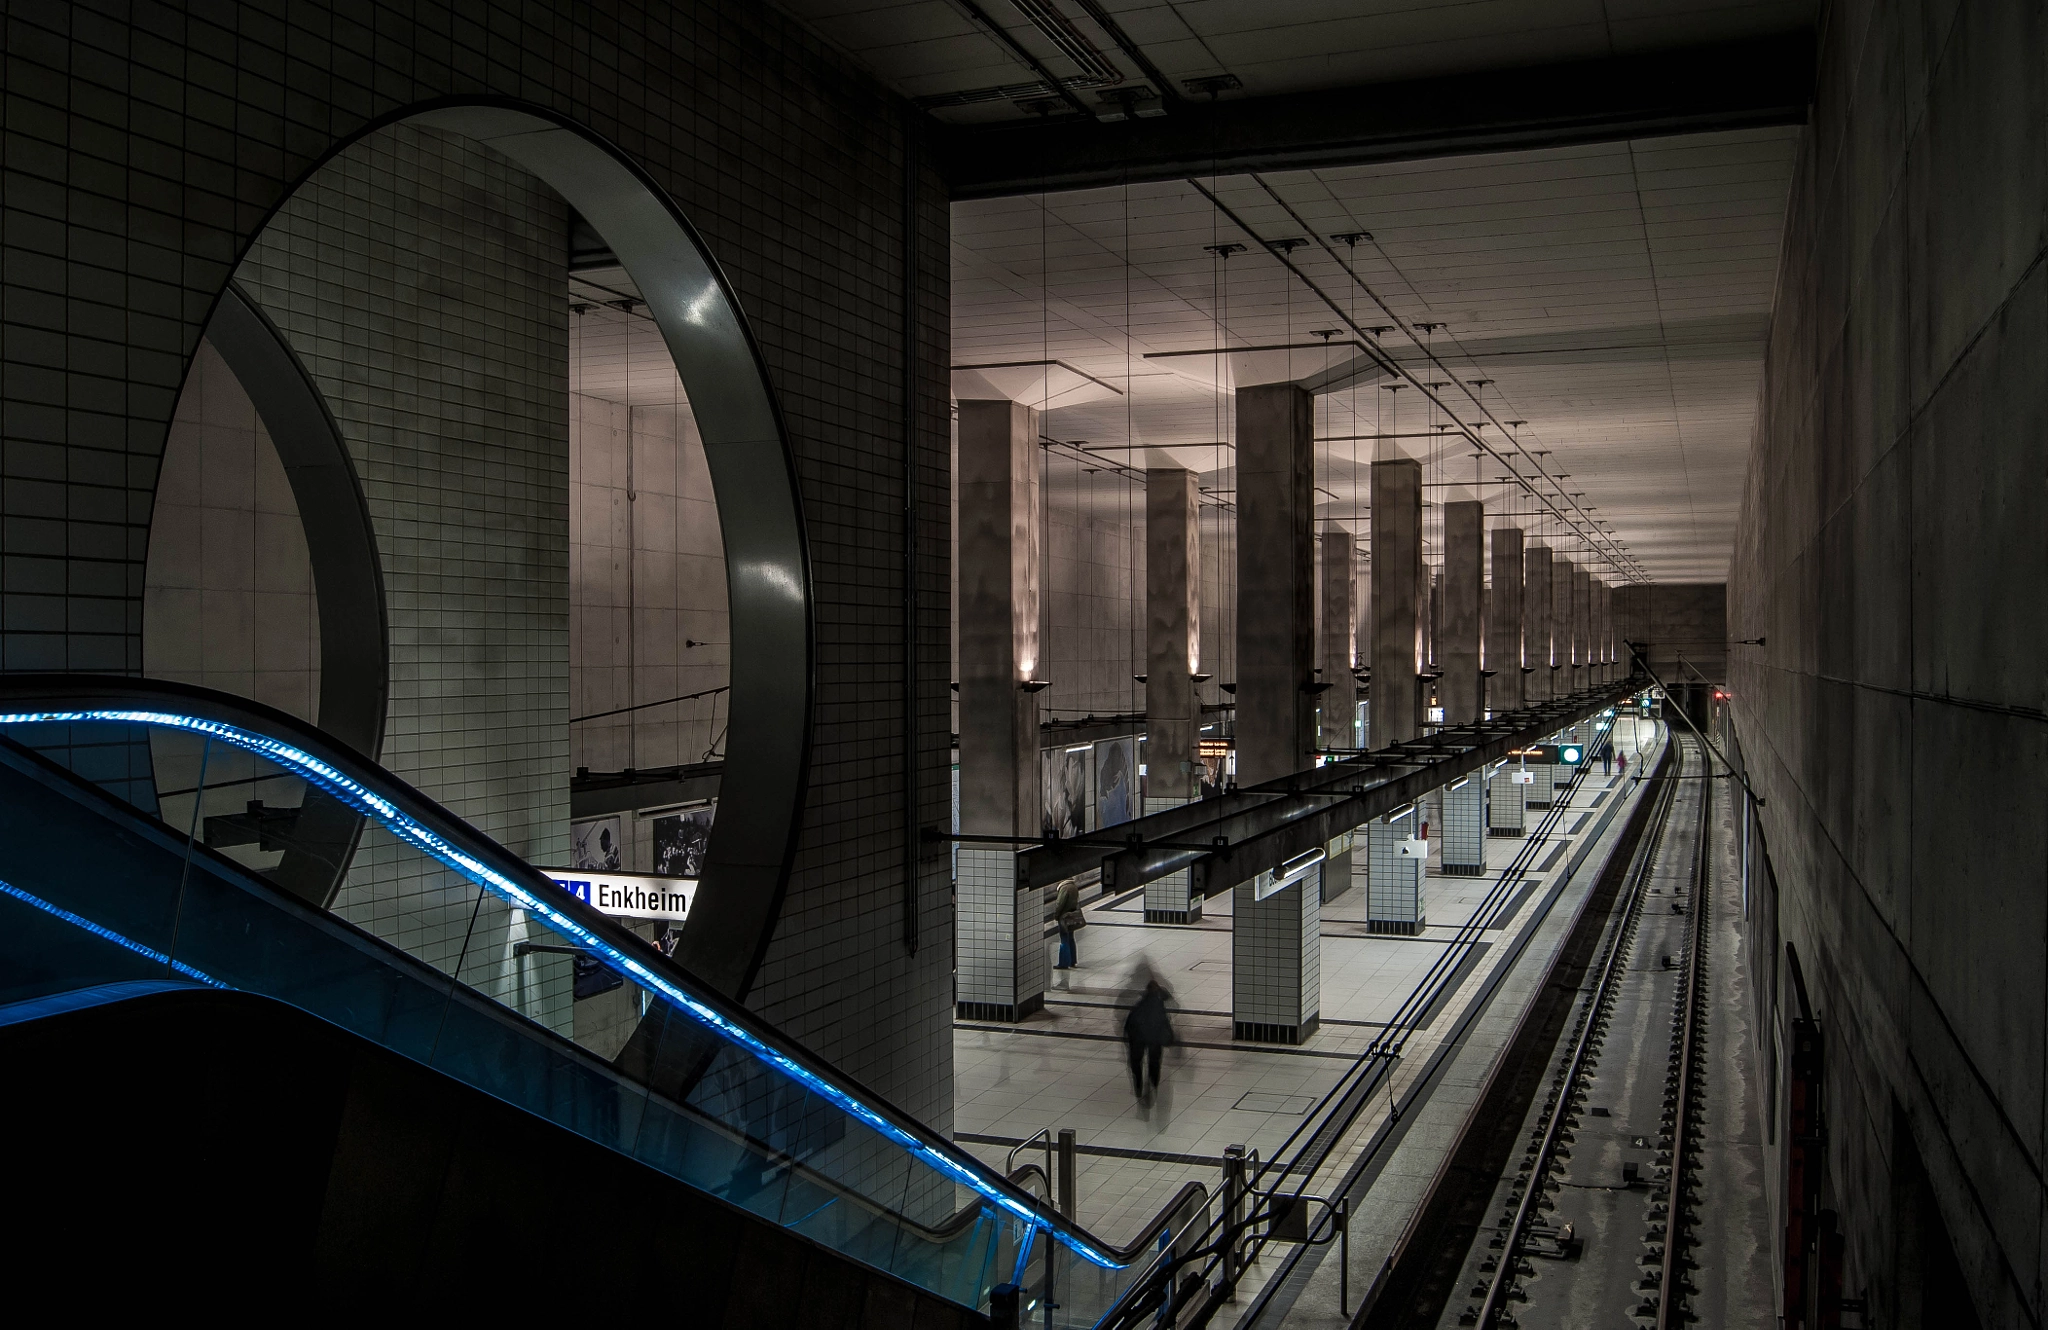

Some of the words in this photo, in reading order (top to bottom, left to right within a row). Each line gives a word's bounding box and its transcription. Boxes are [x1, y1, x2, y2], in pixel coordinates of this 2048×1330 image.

[575, 885, 586, 900] 4
[598, 884, 686, 912] Enkheim
[1635, 1138, 1644, 1147] 4
